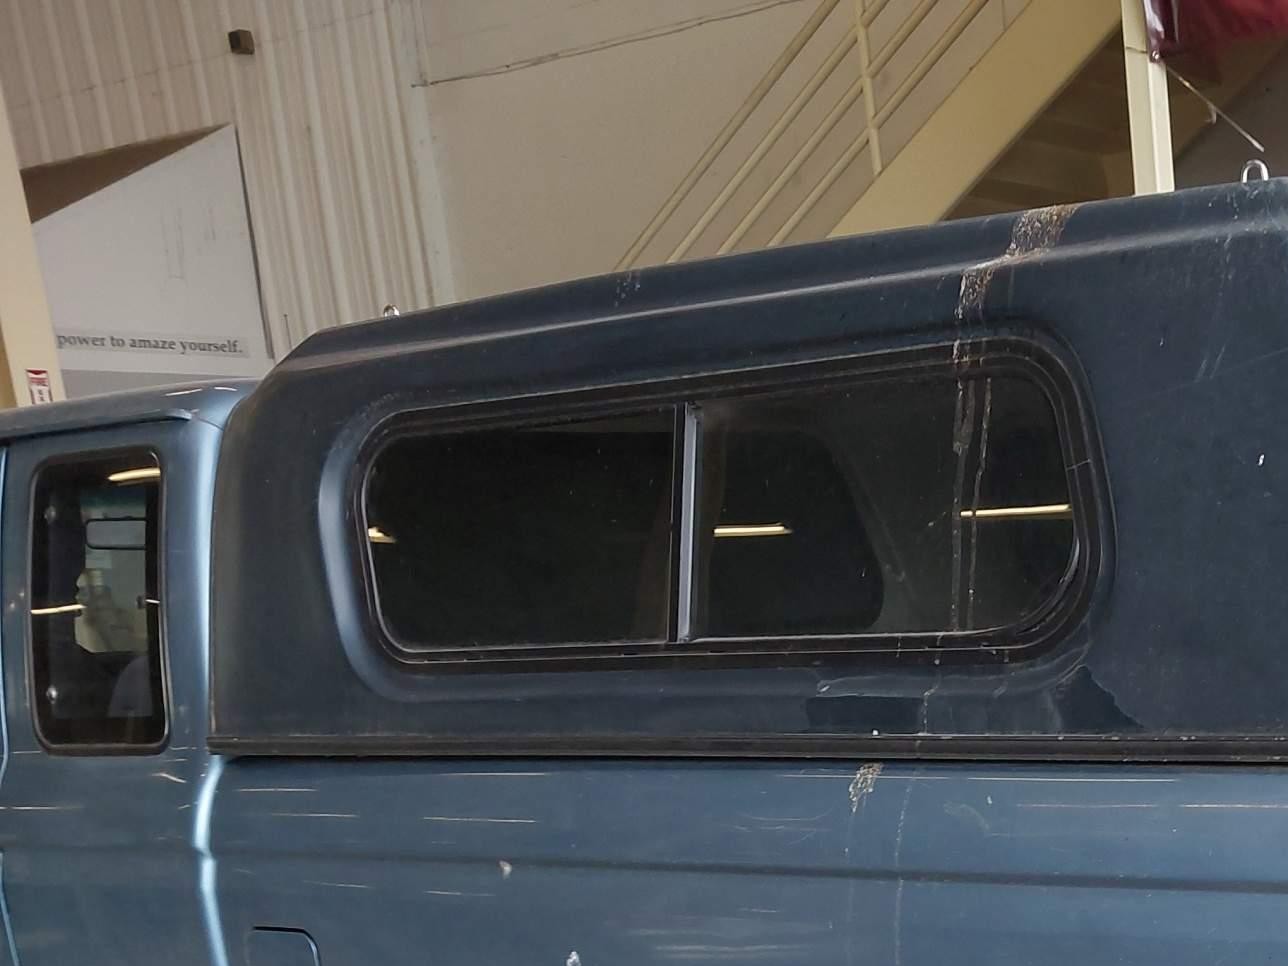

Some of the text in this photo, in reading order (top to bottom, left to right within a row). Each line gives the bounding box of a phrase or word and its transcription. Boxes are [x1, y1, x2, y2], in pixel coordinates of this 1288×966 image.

[58, 333, 244, 355] power to amaze yourself.
